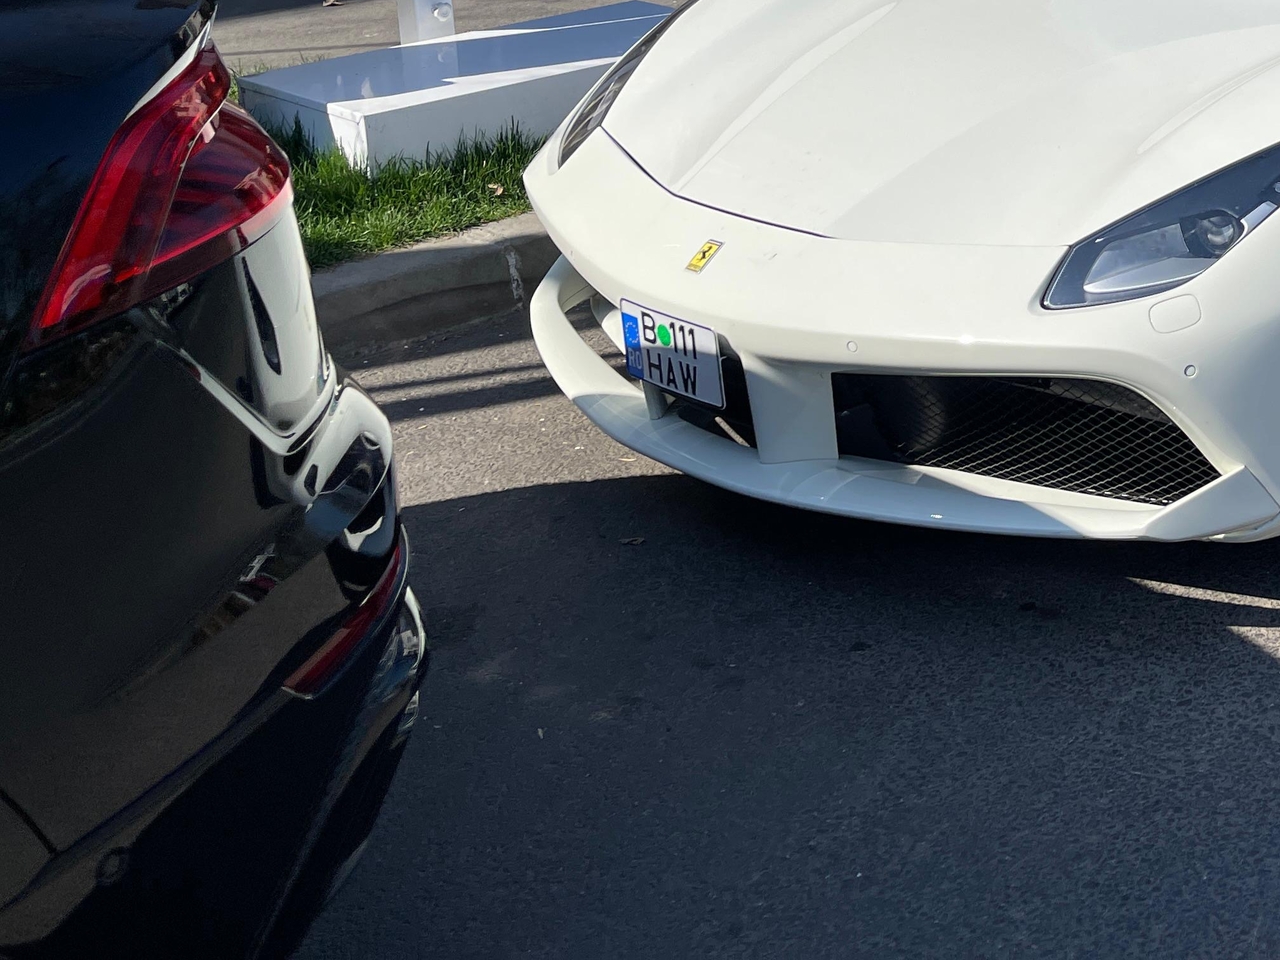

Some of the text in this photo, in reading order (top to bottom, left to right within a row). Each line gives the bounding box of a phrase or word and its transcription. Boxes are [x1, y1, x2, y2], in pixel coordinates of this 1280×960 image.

[628, 347, 643, 370] RO
[641, 311, 697, 360] B 111
[646, 348, 697, 396] HAW
